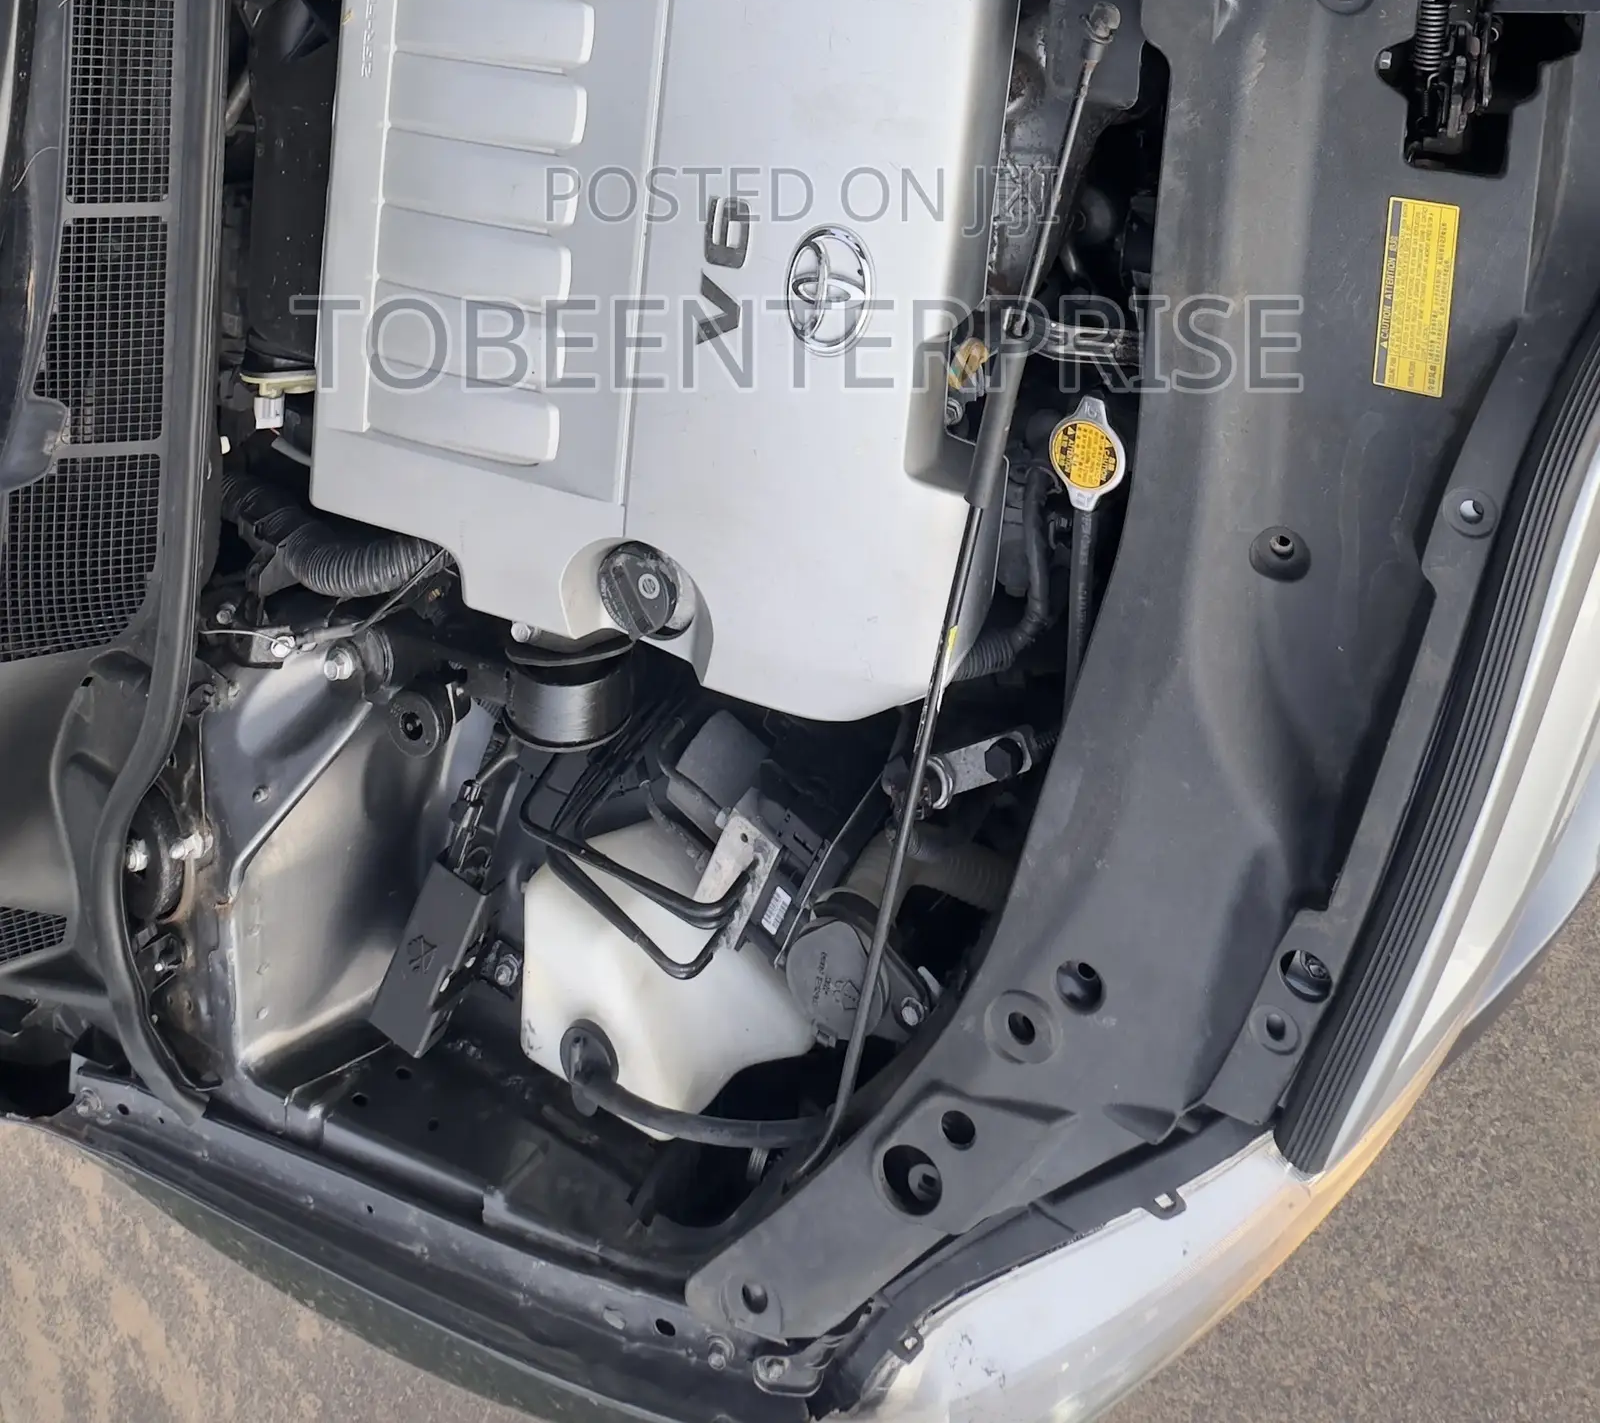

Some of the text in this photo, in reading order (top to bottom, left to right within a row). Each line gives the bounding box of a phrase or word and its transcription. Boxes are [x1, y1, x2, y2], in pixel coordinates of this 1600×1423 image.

[695, 196, 751, 345] V6
[1385, 257, 1396, 300] ATTENTION
[1381, 305, 1391, 339] CAUTION
